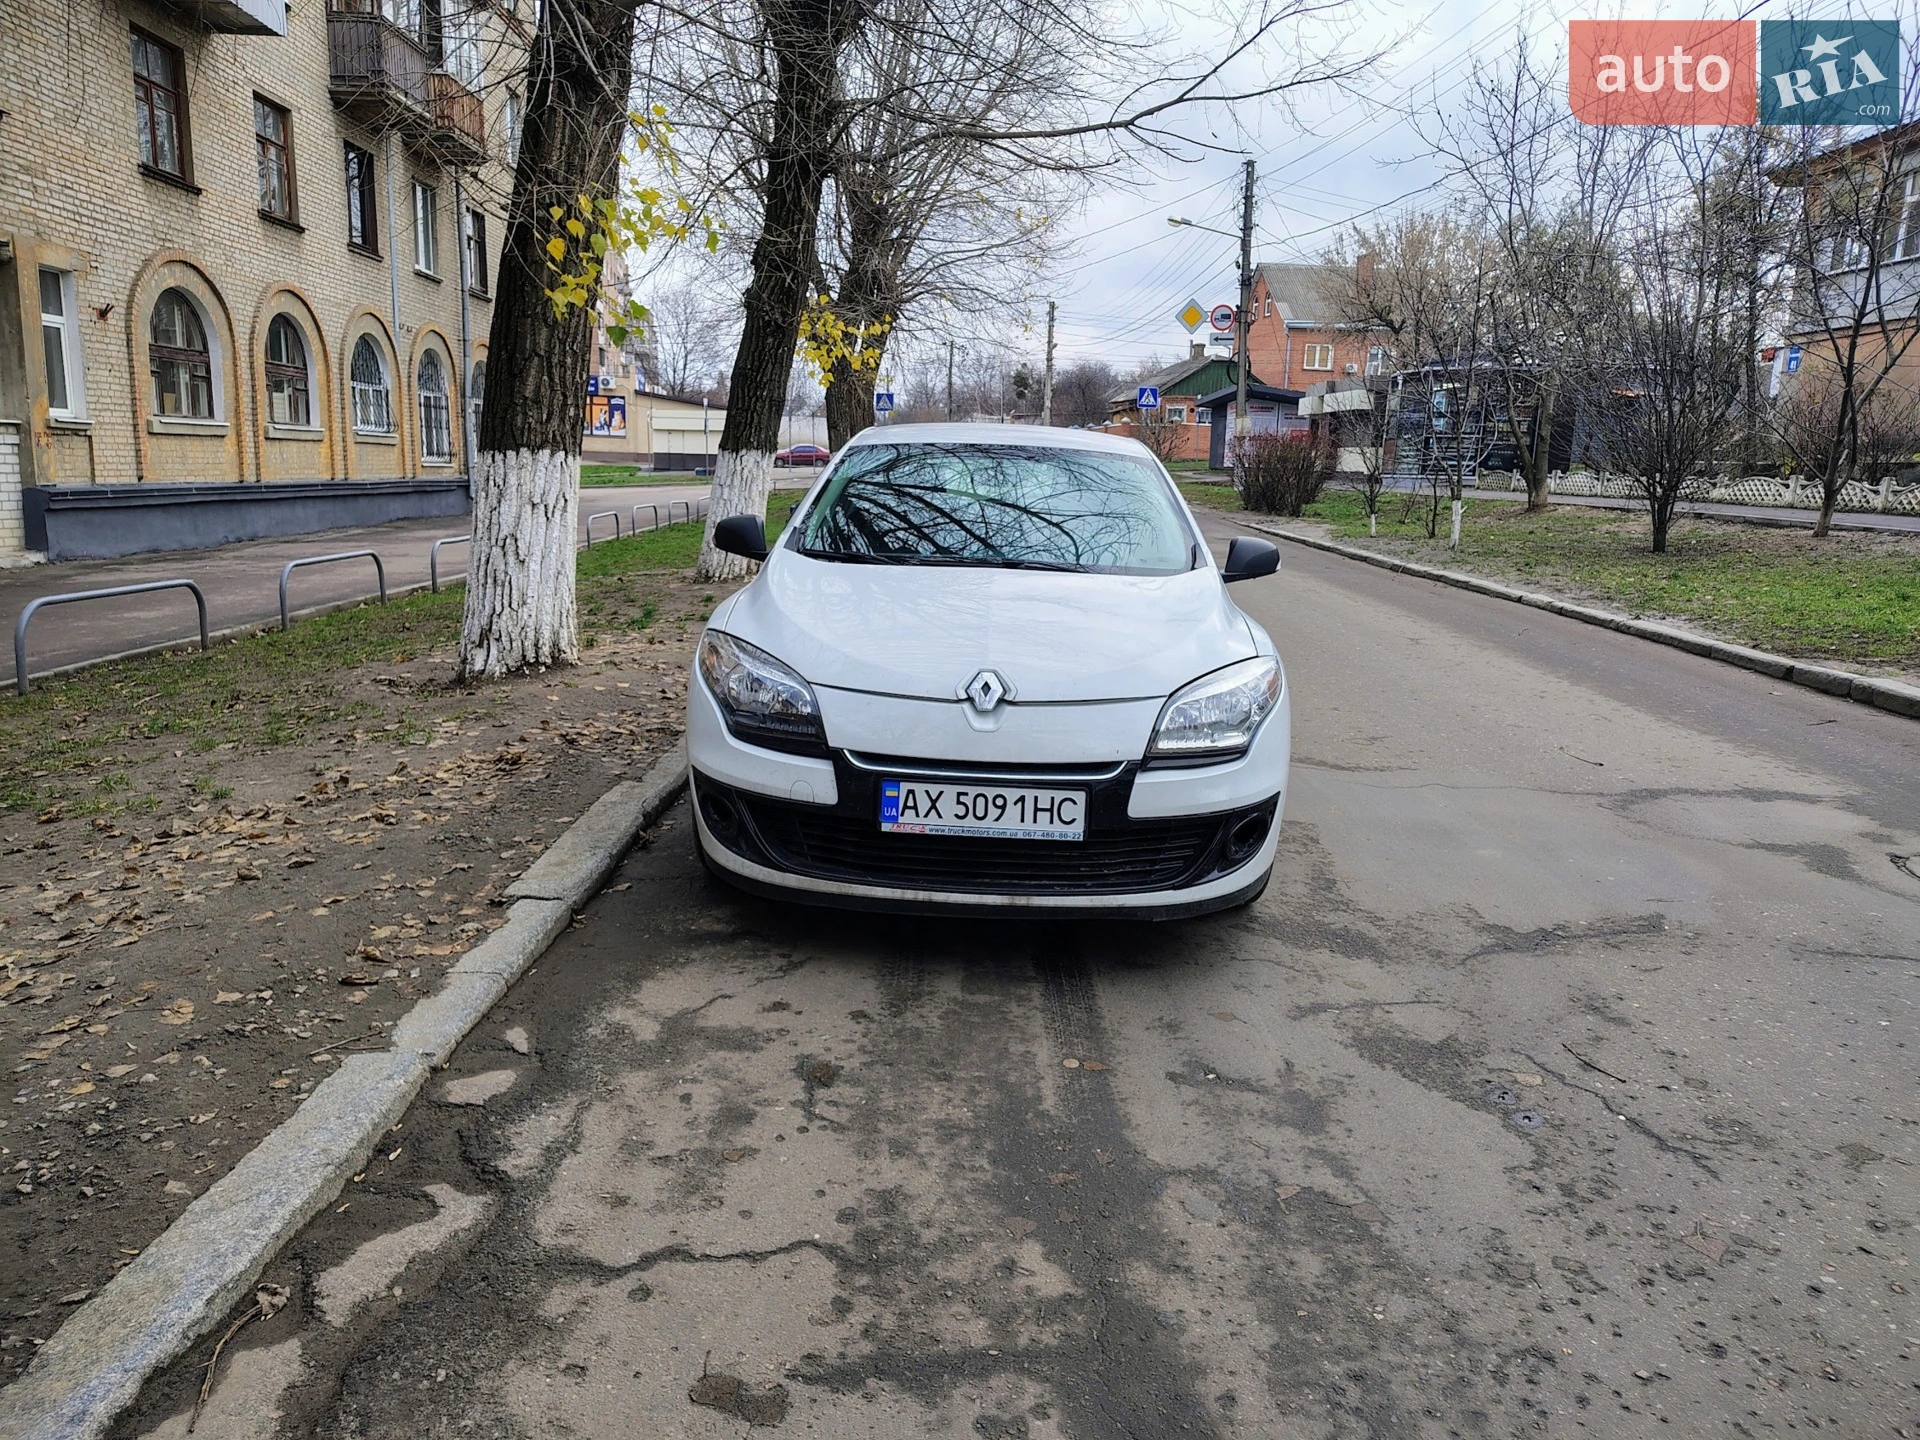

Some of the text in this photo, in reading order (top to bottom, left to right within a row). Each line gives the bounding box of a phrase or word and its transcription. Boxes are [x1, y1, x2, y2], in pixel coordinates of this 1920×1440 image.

[900, 788, 945, 819] AX
[884, 807, 898, 817] UA
[928, 827, 1018, 836] www.truckmotors.com.ua
[1022, 831, 1082, 840] 067-480-80-22
